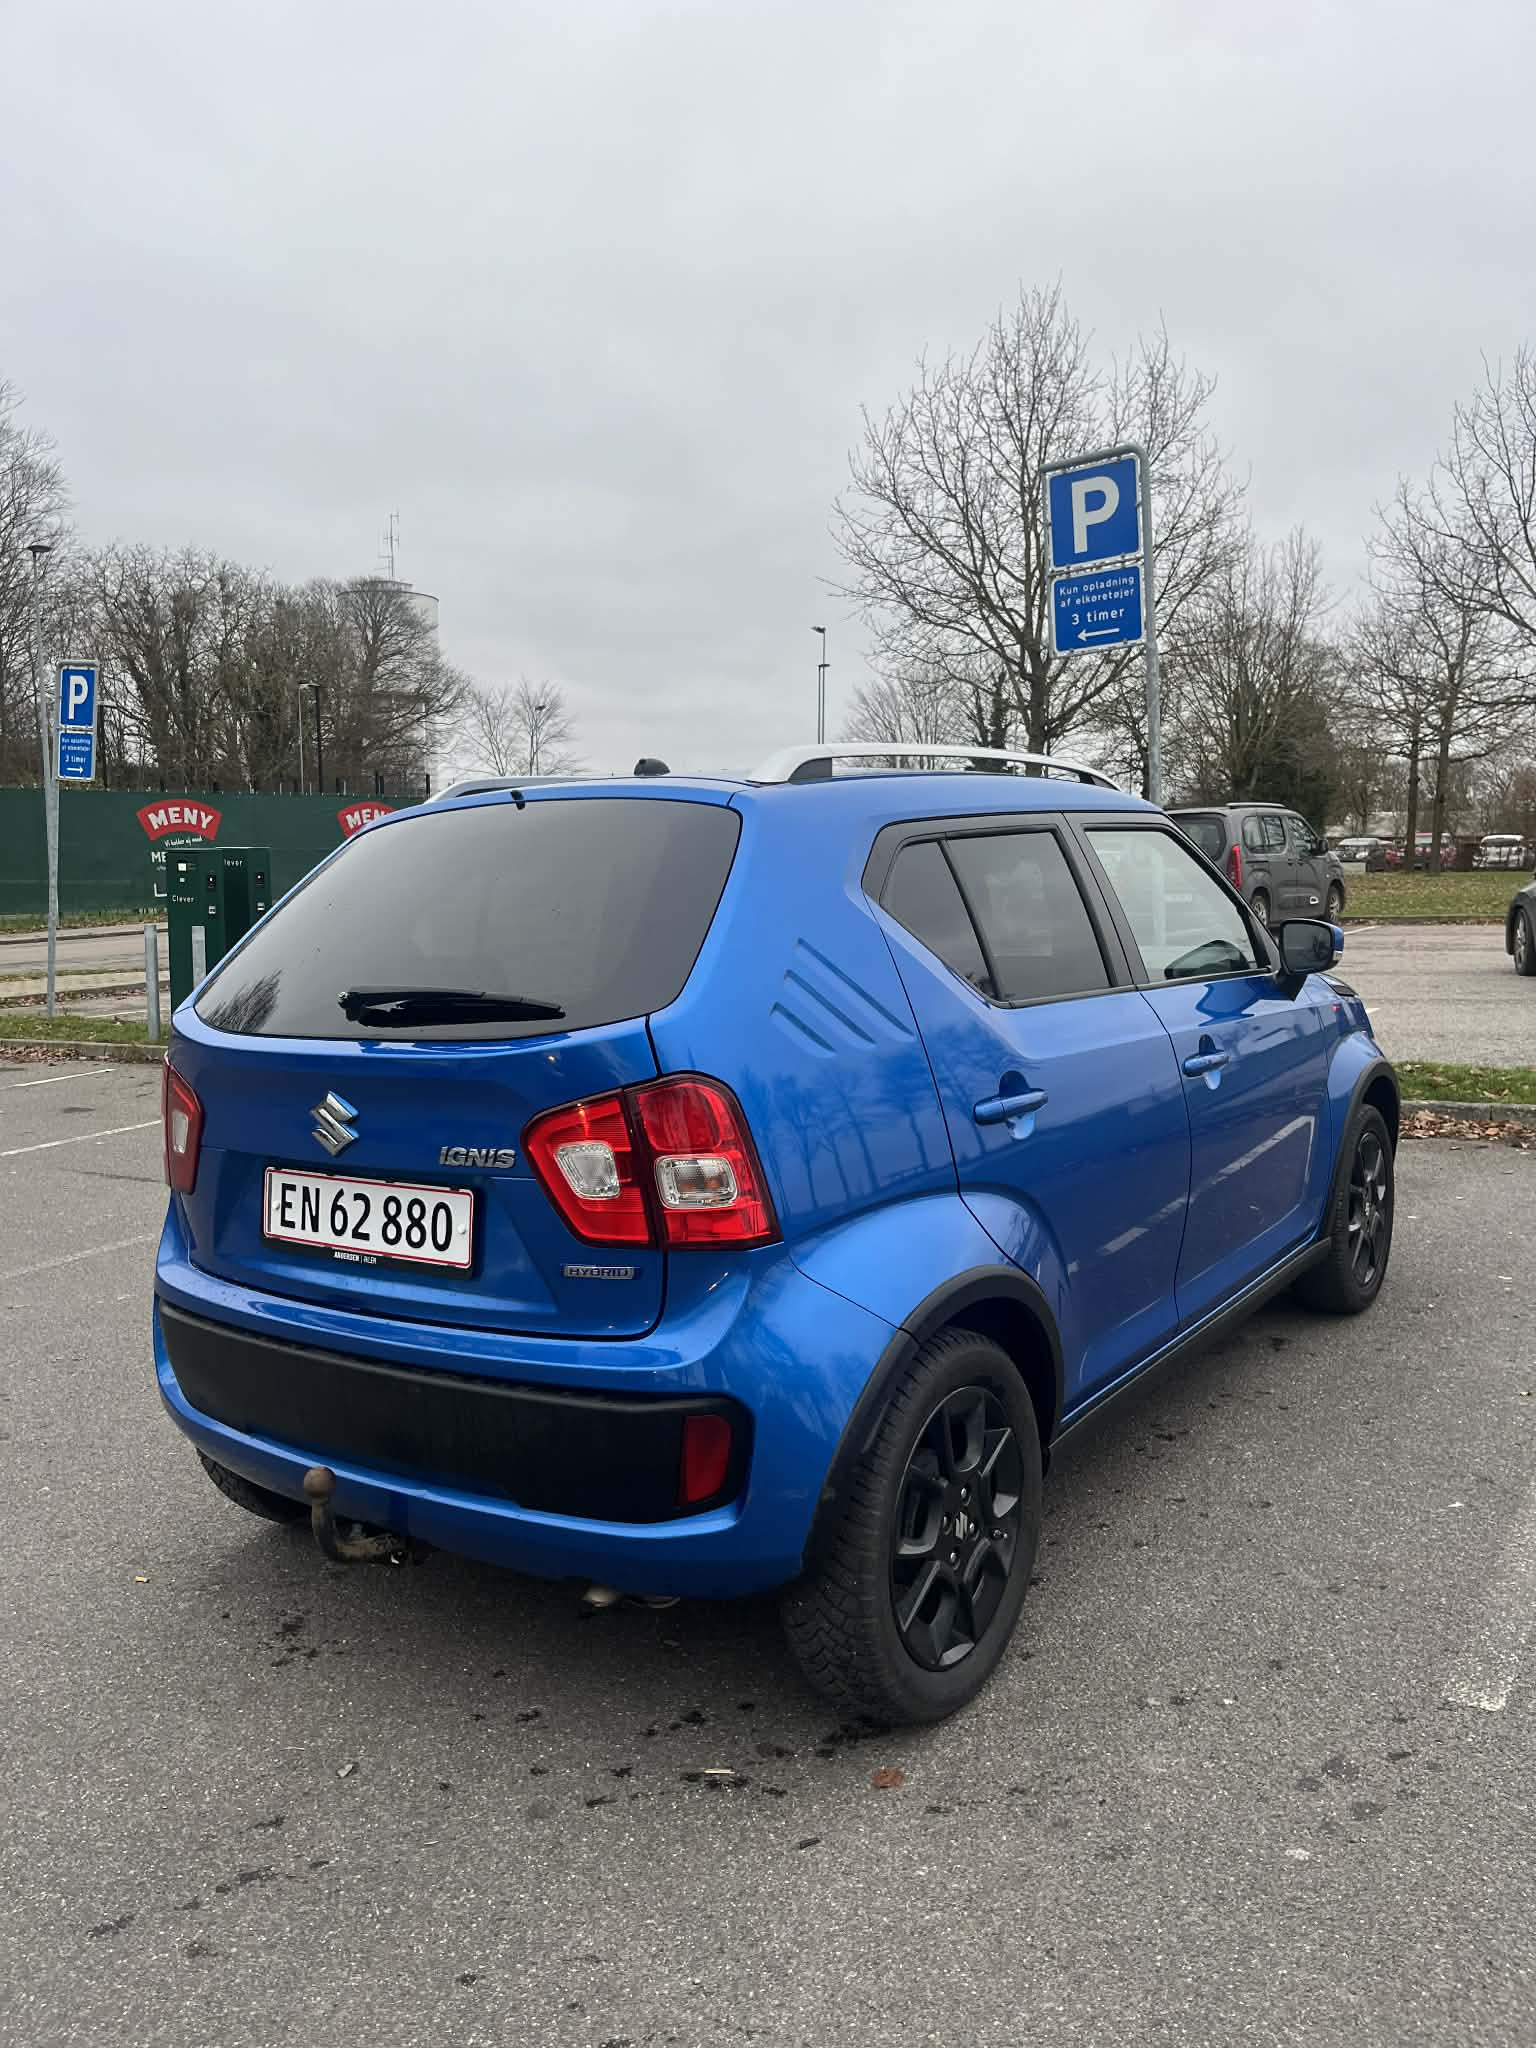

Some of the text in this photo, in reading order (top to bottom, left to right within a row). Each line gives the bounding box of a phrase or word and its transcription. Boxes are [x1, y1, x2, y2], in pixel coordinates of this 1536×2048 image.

[1071, 475, 1120, 554] P
[1060, 576, 1135, 596] Kun opladning
[1060, 598, 1071, 608] af
[1071, 608, 1125, 626] 3 timer
[68, 675, 89, 720] P
[147, 806, 214, 831] MENY
[345, 808, 389, 830] MEN
[151, 851, 168, 863] ME
[223, 857, 243, 867] lever
[172, 895, 195, 903] Clever
[439, 1146, 516, 1169] IGNIS
[280, 1182, 453, 1252] EN 62 880
[568, 1266, 630, 1278] HYBRID
